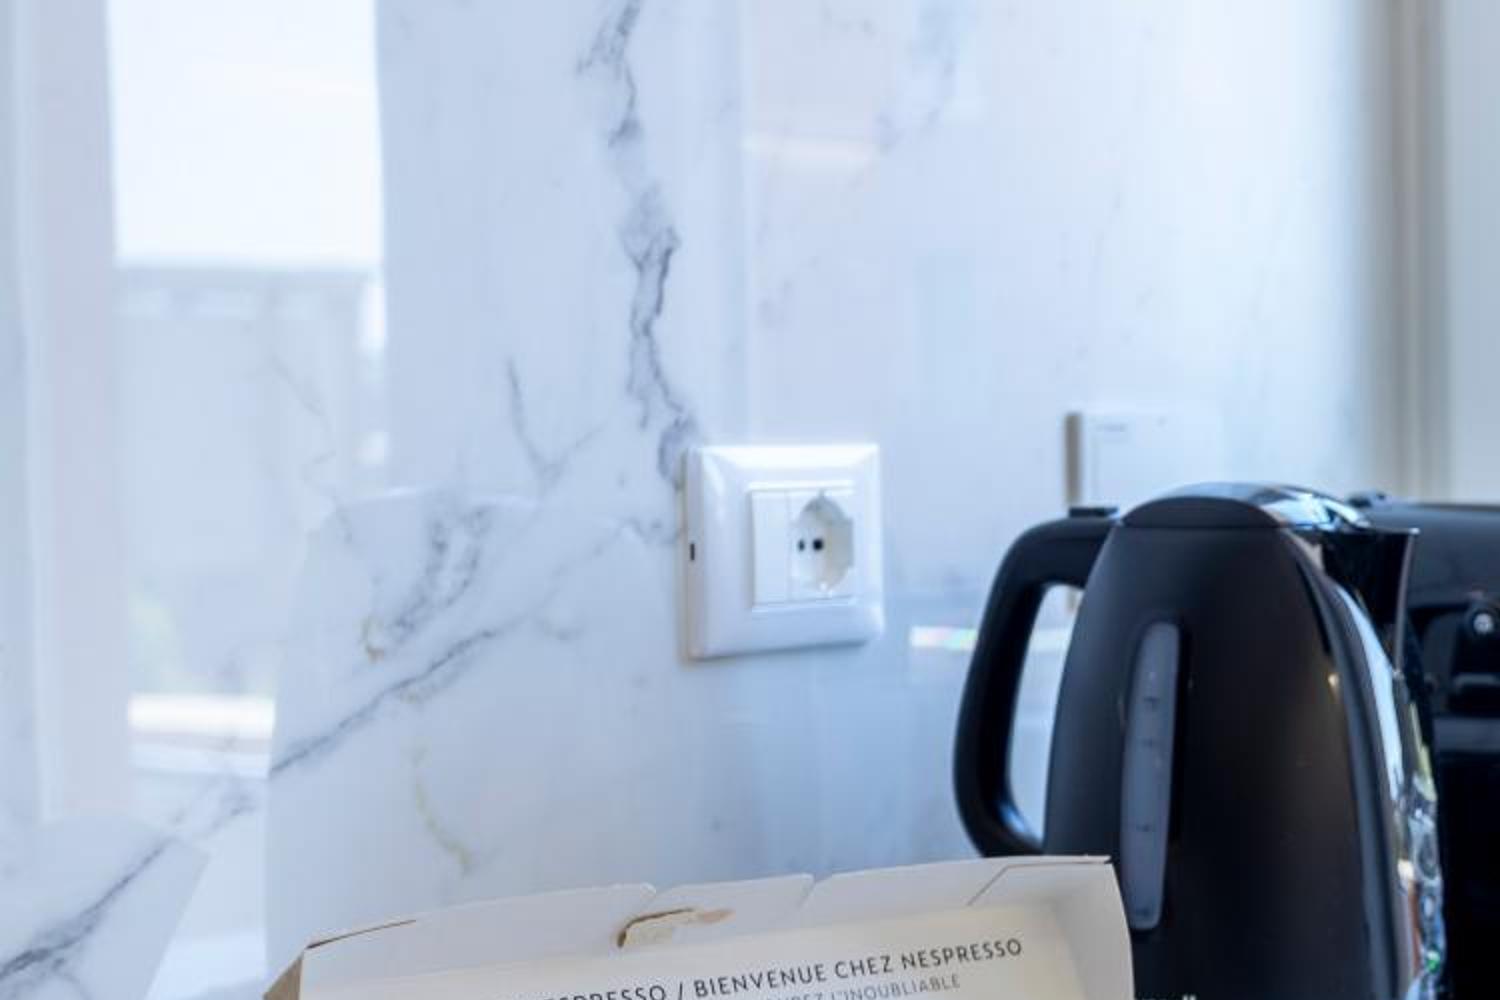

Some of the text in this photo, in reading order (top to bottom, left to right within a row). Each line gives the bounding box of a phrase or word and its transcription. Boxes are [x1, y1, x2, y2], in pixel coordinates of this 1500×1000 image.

[694, 964, 827, 998] BIENVENUE
[834, 955, 893, 979] CHEZ
[901, 938, 1023, 970] NESPRESSO
